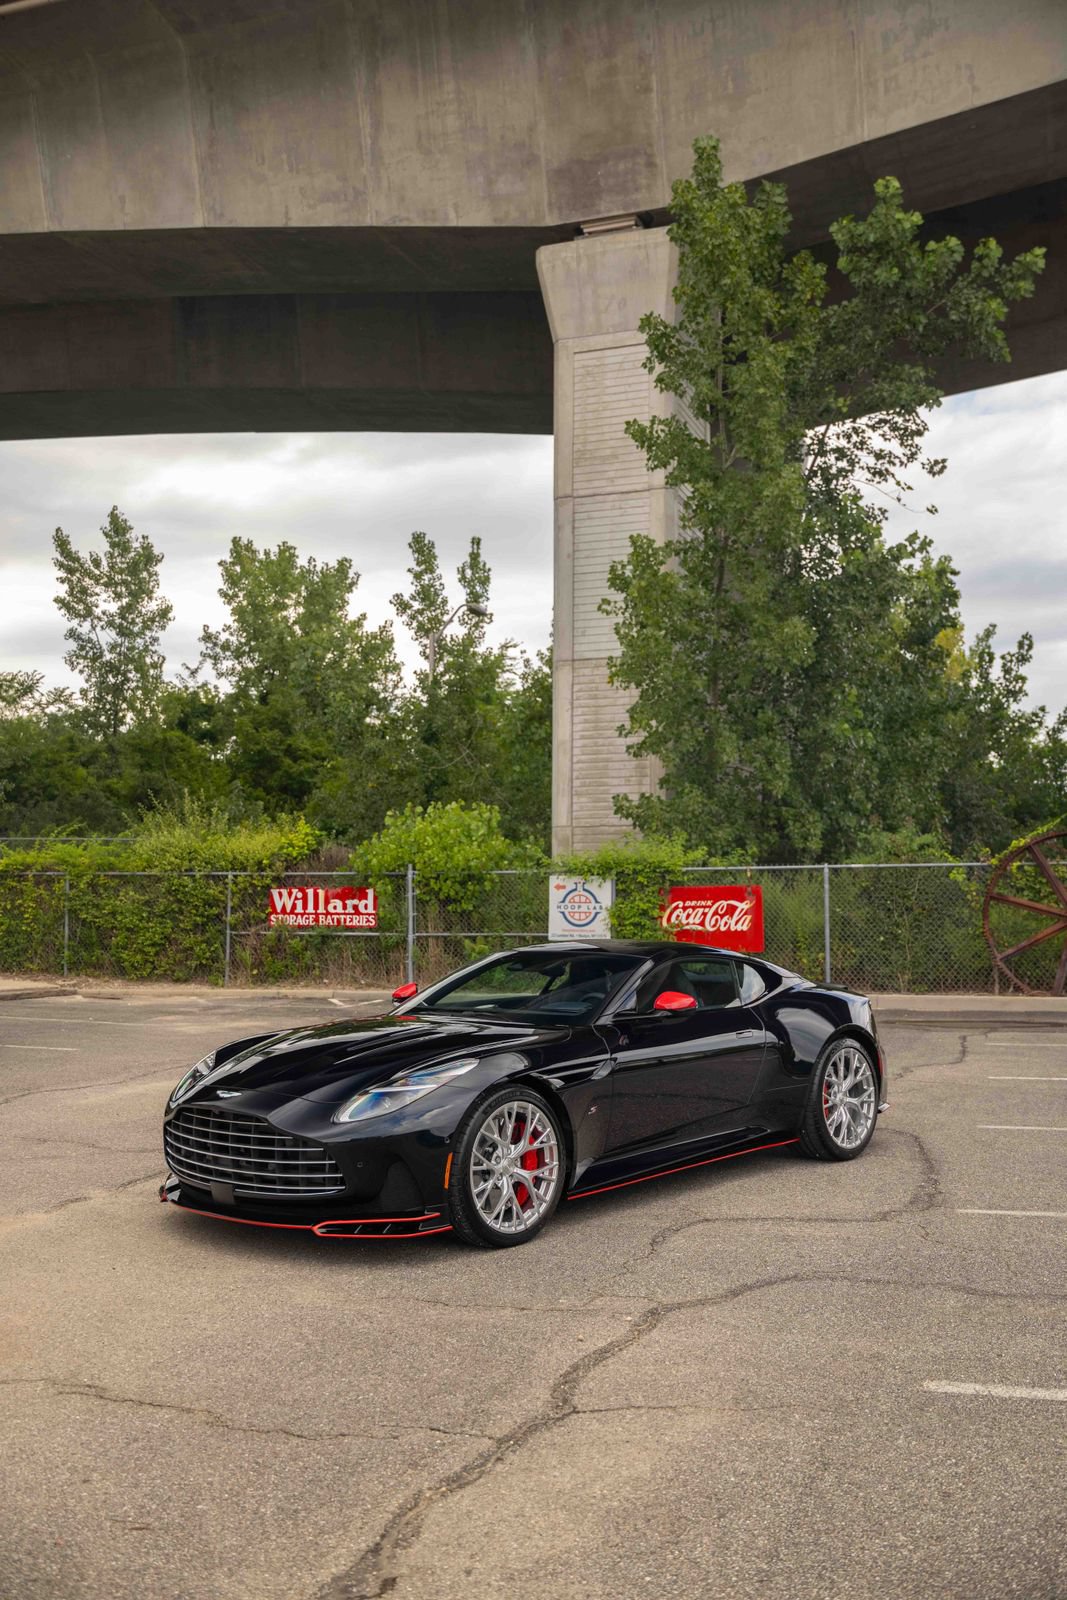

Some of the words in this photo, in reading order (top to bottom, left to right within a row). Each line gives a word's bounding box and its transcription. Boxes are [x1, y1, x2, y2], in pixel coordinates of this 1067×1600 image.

[270, 888, 376, 914] Willard
[270, 914, 316, 926] STORAGE
[319, 914, 376, 926] BATTERIES
[662, 900, 756, 932] Coca-Cola
